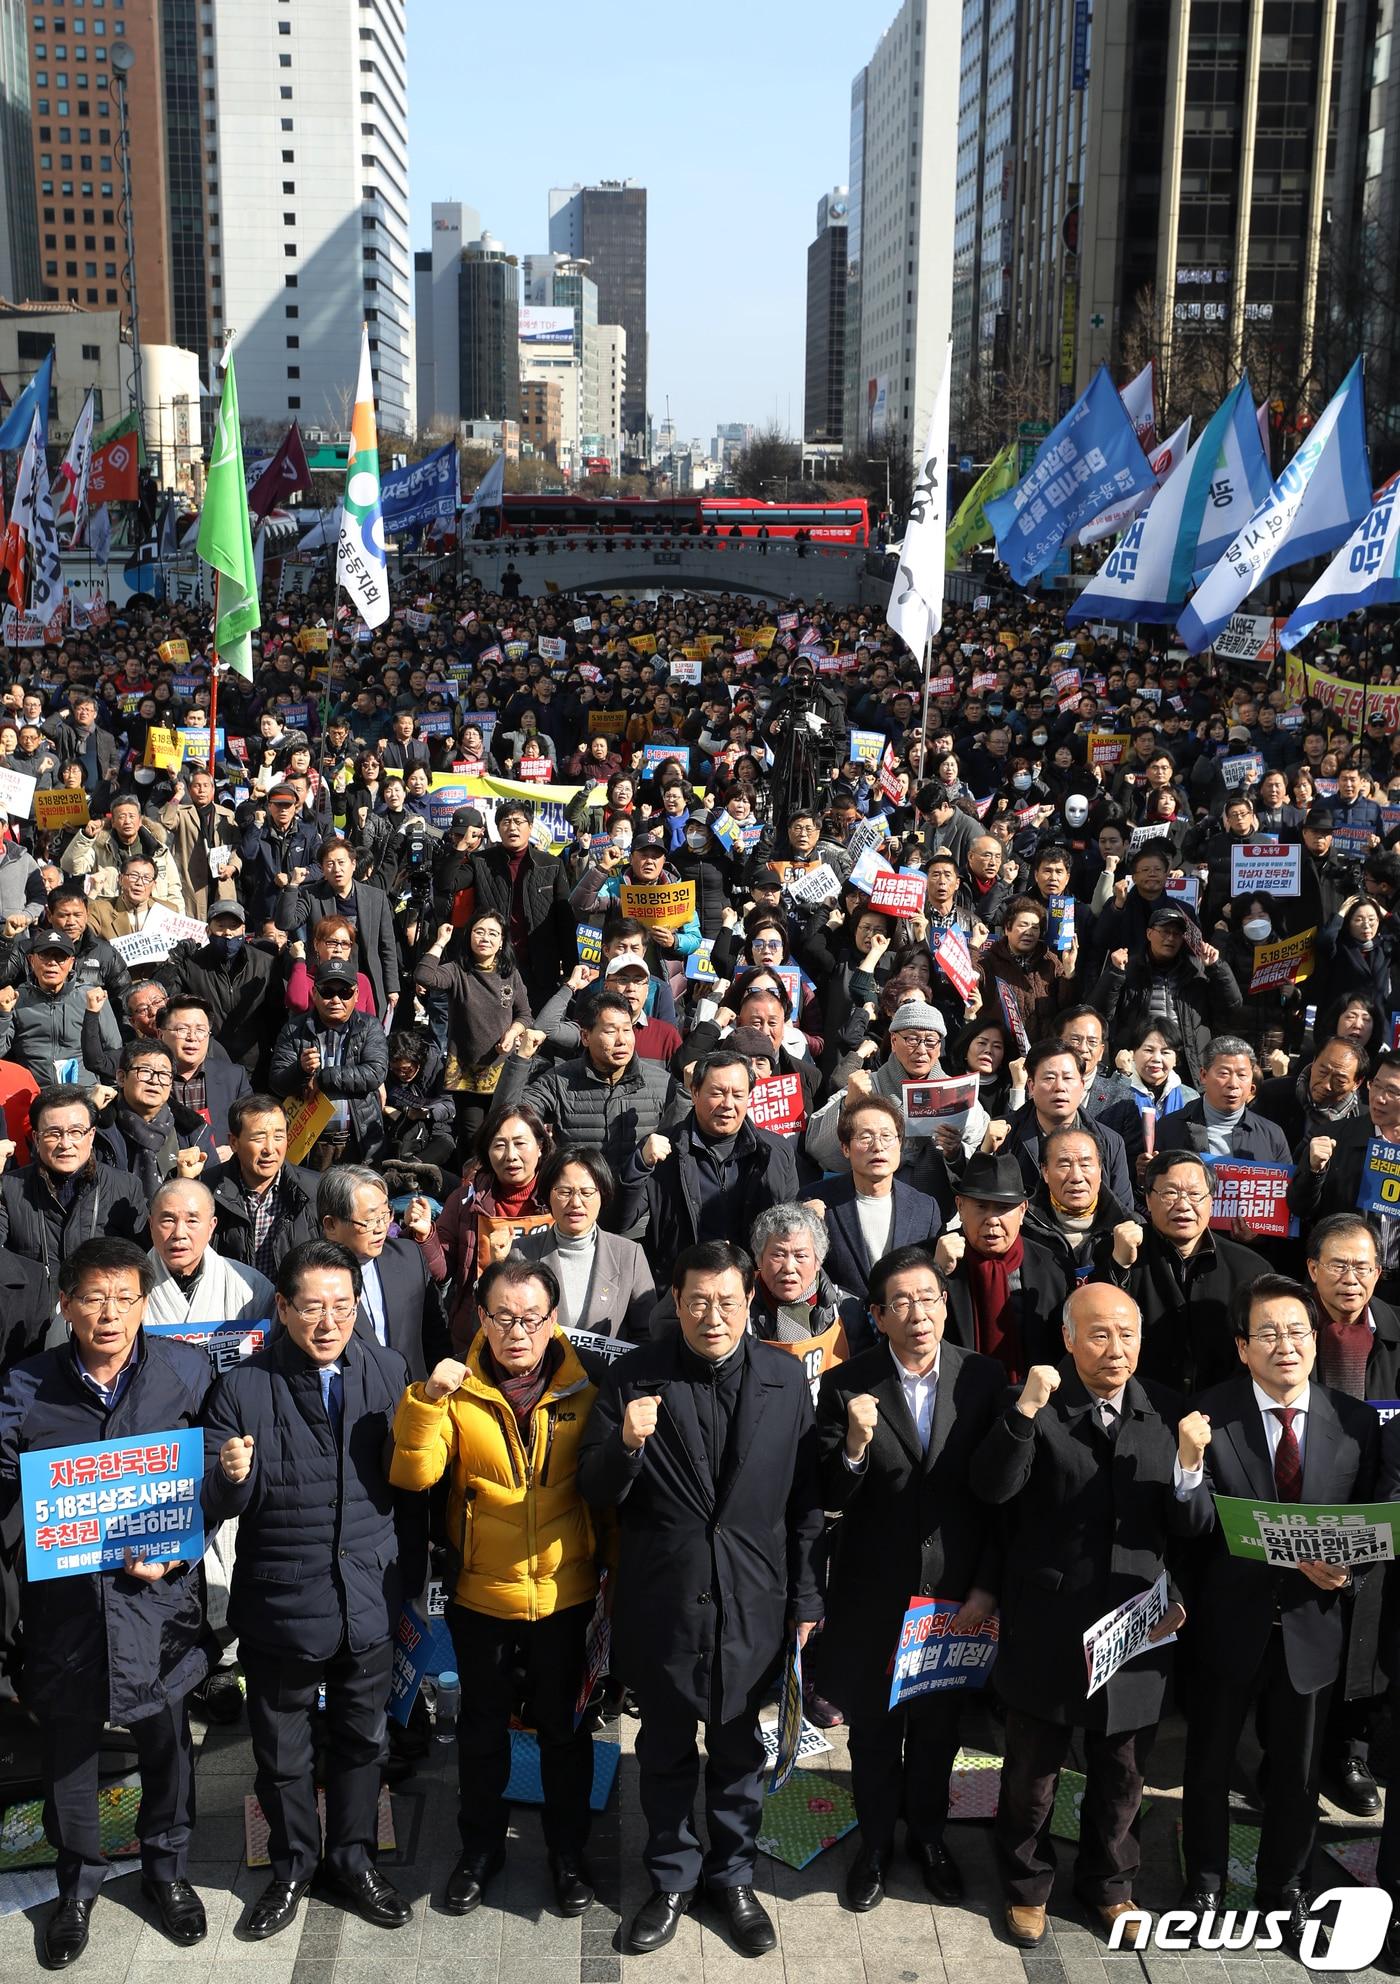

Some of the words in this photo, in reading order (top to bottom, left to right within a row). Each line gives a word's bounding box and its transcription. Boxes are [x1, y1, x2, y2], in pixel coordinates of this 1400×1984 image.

[38, 796, 52, 806] 5.18
[1238, 869, 1263, 878] 학살자
[873, 877, 924, 894] 자유한국당
[1237, 880, 1254, 889] 다시
[1255, 879, 1292, 889] 법정으로!
[626, 893, 648, 905] 5.18
[649, 891, 671, 905] 망언
[672, 888, 689, 902] 3인
[627, 905, 666, 919] 국회의원
[1260, 952, 1280, 964] 5.18
[1281, 944, 1299, 959] 망언
[748, 1076, 797, 1107] 한국당
[50, 1443, 179, 1489] 자유한국당!
[35, 1478, 195, 1523] 5·18진상조사위원
[36, 1519, 100, 1551] 추천권
[105, 1506, 194, 1540] 반납하라!
[1263, 1527, 1337, 1538] 5.18모독
[1265, 1533, 1377, 1552] 역사왜곡
[57, 1547, 124, 1570] 더불어민주당
[895, 1643, 943, 1683] 처벌법
[943, 1641, 994, 1668] 제정!
